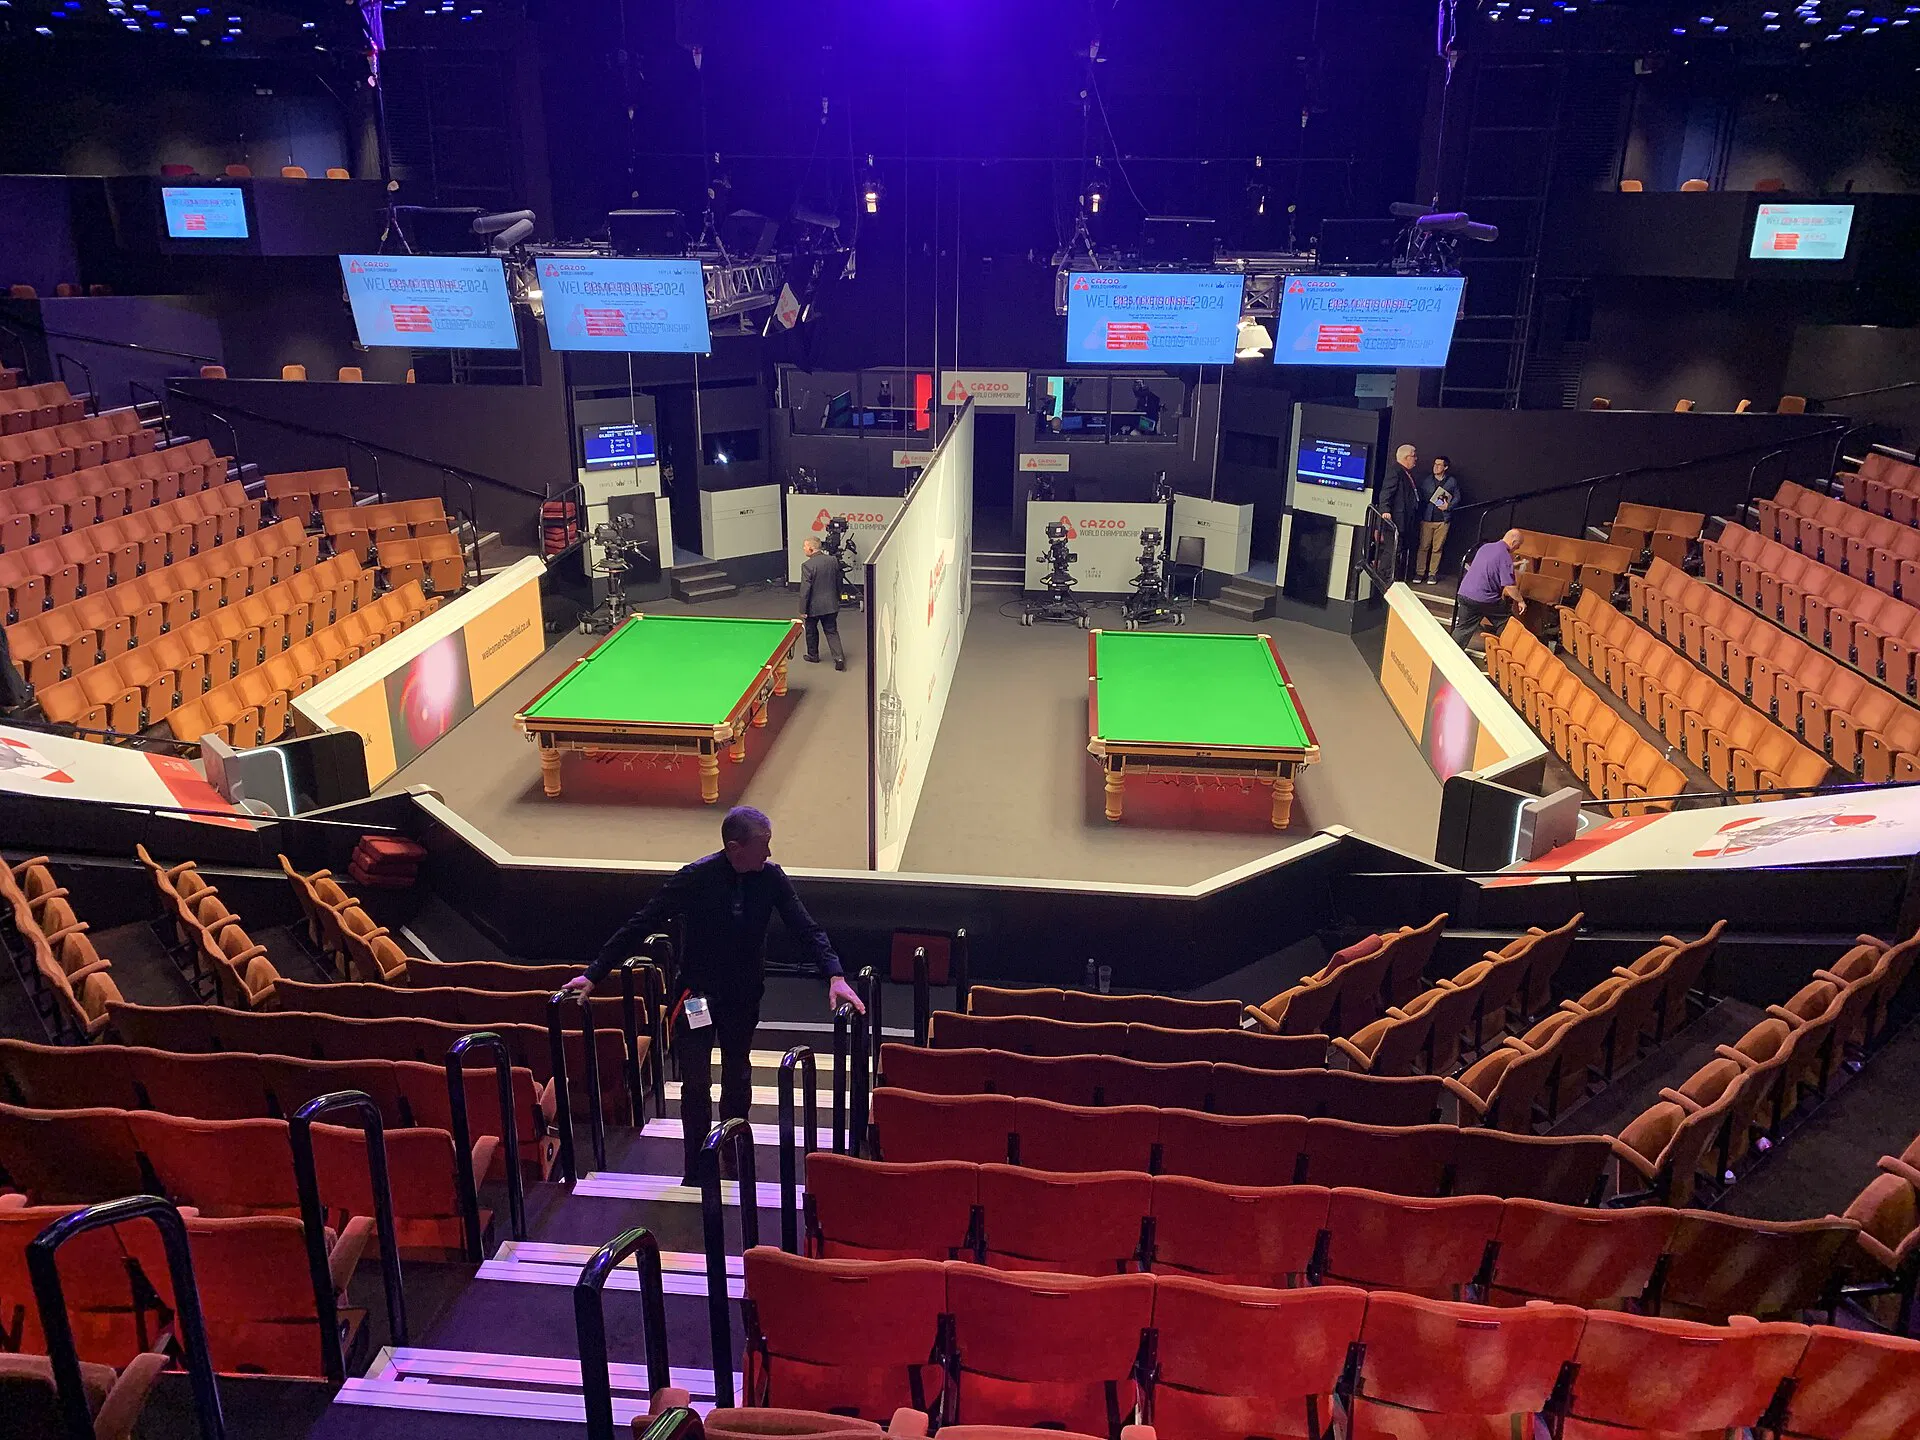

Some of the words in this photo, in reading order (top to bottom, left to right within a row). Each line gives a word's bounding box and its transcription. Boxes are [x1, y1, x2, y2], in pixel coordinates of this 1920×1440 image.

[461, 279, 489, 293] 2024
[658, 282, 685, 296] 2024
[1194, 296, 1224, 310] 2024
[1411, 299, 1441, 312] 2024
[970, 383, 1009, 391] CAZOO
[1080, 520, 1126, 529] CAZOO
[1080, 529, 1099, 537] WORLD
[1100, 529, 1140, 537] CHAMPIONSHIP
